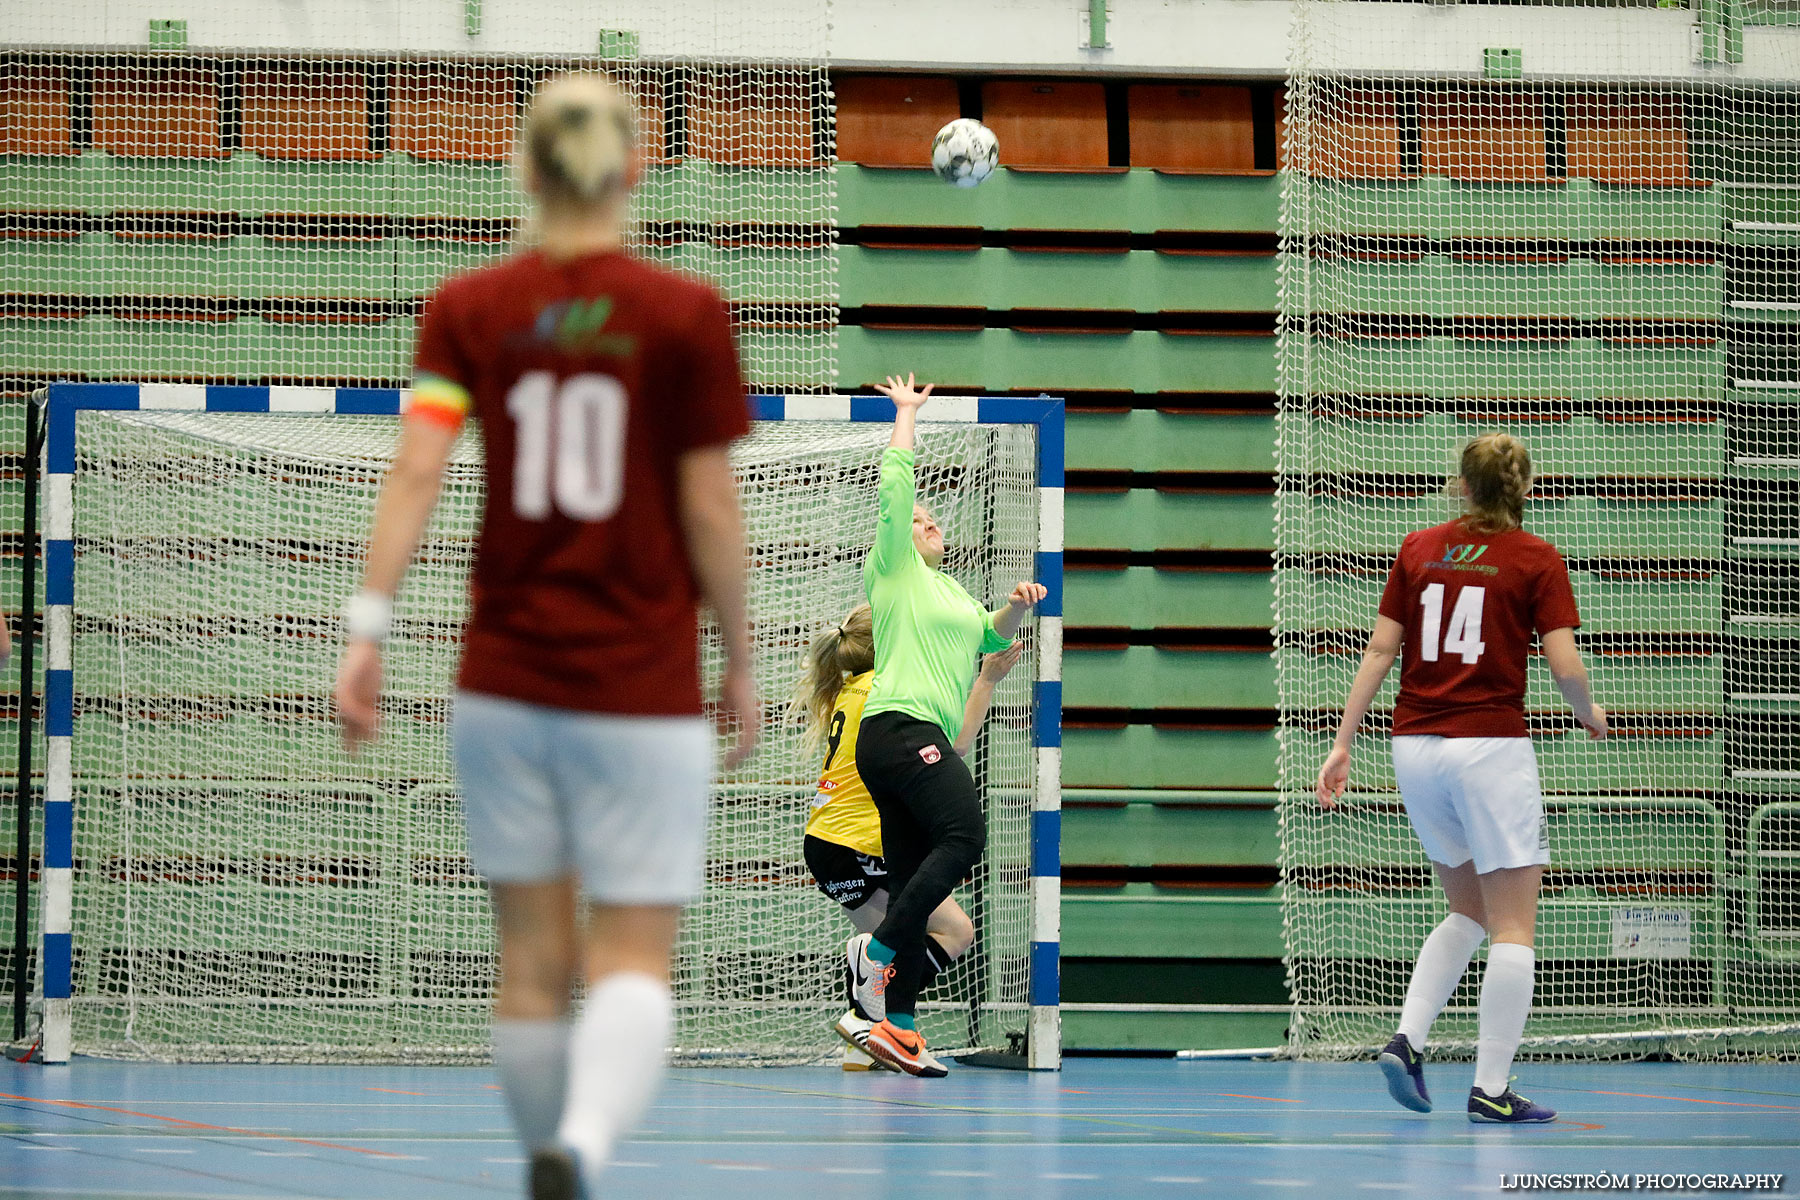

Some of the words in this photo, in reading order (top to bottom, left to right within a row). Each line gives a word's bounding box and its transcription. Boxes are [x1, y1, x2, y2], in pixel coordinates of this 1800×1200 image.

[506, 371, 629, 521] 10
[1420, 583, 1486, 664] 14
[825, 711, 846, 771] 9
